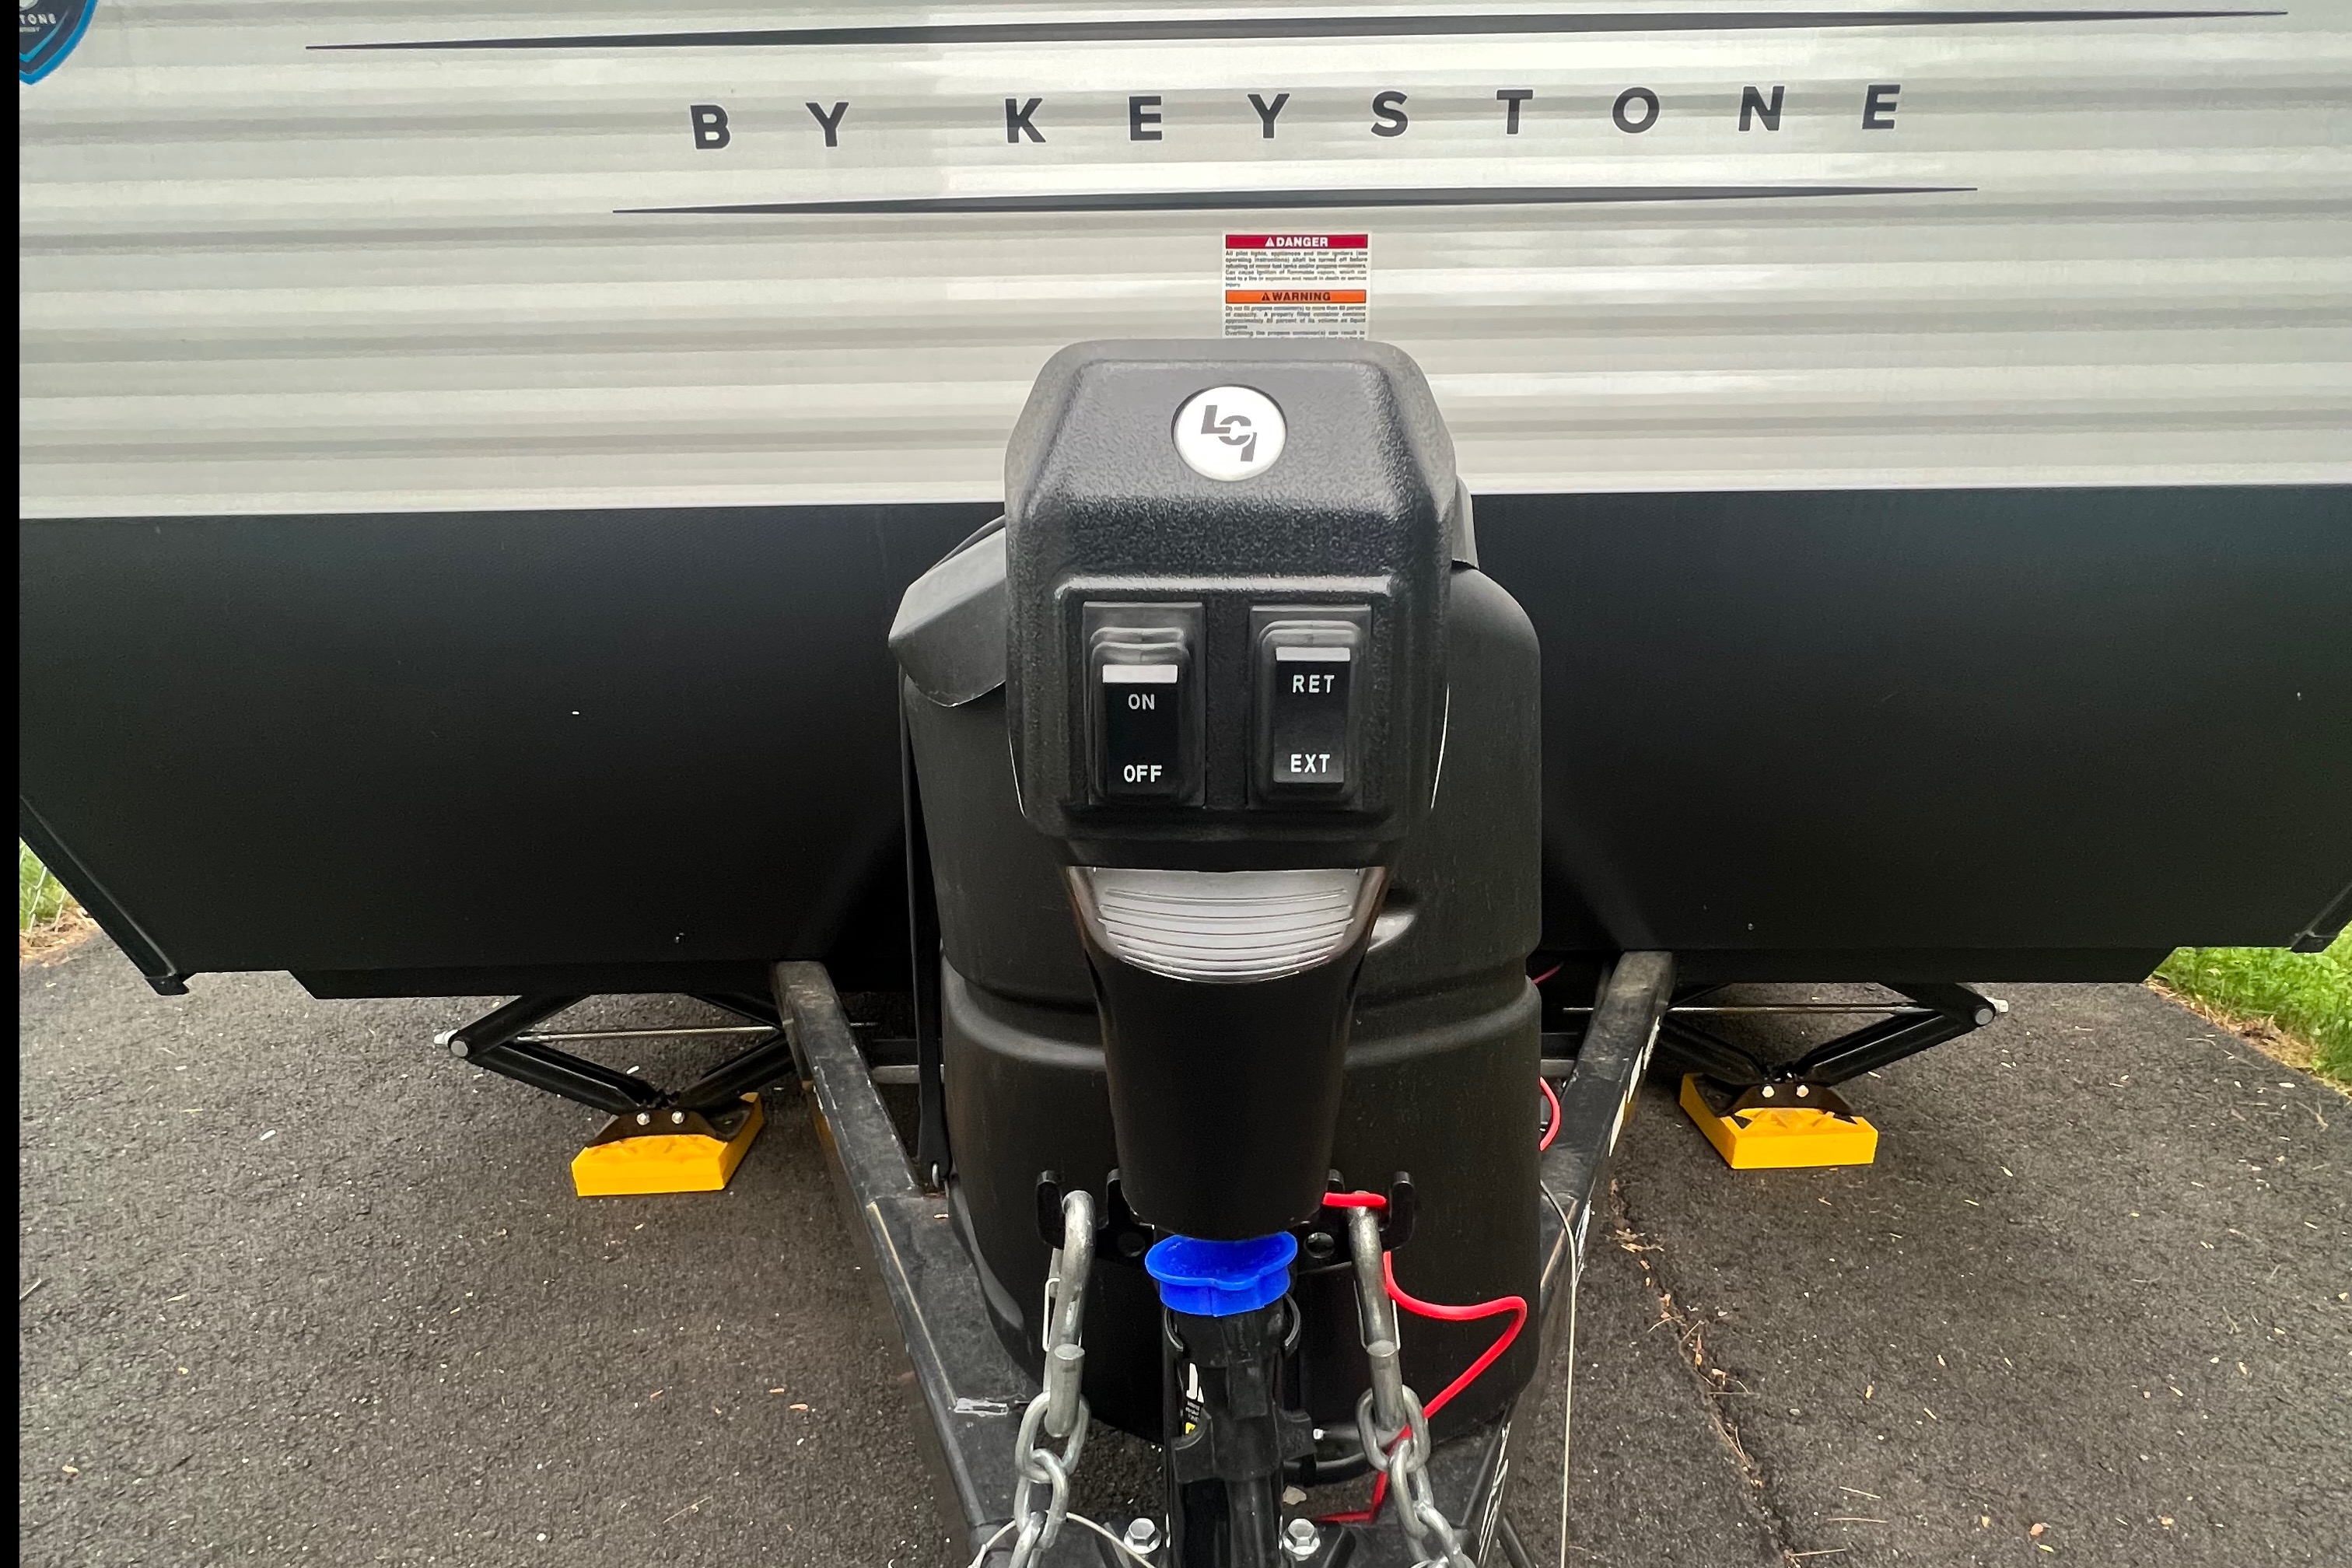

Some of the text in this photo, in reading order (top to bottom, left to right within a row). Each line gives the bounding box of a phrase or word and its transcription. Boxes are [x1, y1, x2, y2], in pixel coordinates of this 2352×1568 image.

[690, 84, 1900, 149] BY KEYSTONE
[1276, 237, 1328, 247] DANGER
[1272, 292, 1331, 301] WARNING
[1201, 405, 1257, 462] LCI
[1292, 674, 1335, 694] RET
[1128, 693, 1155, 711] ON
[1290, 754, 1330, 773] EXT
[1123, 765, 1162, 782] OFF
